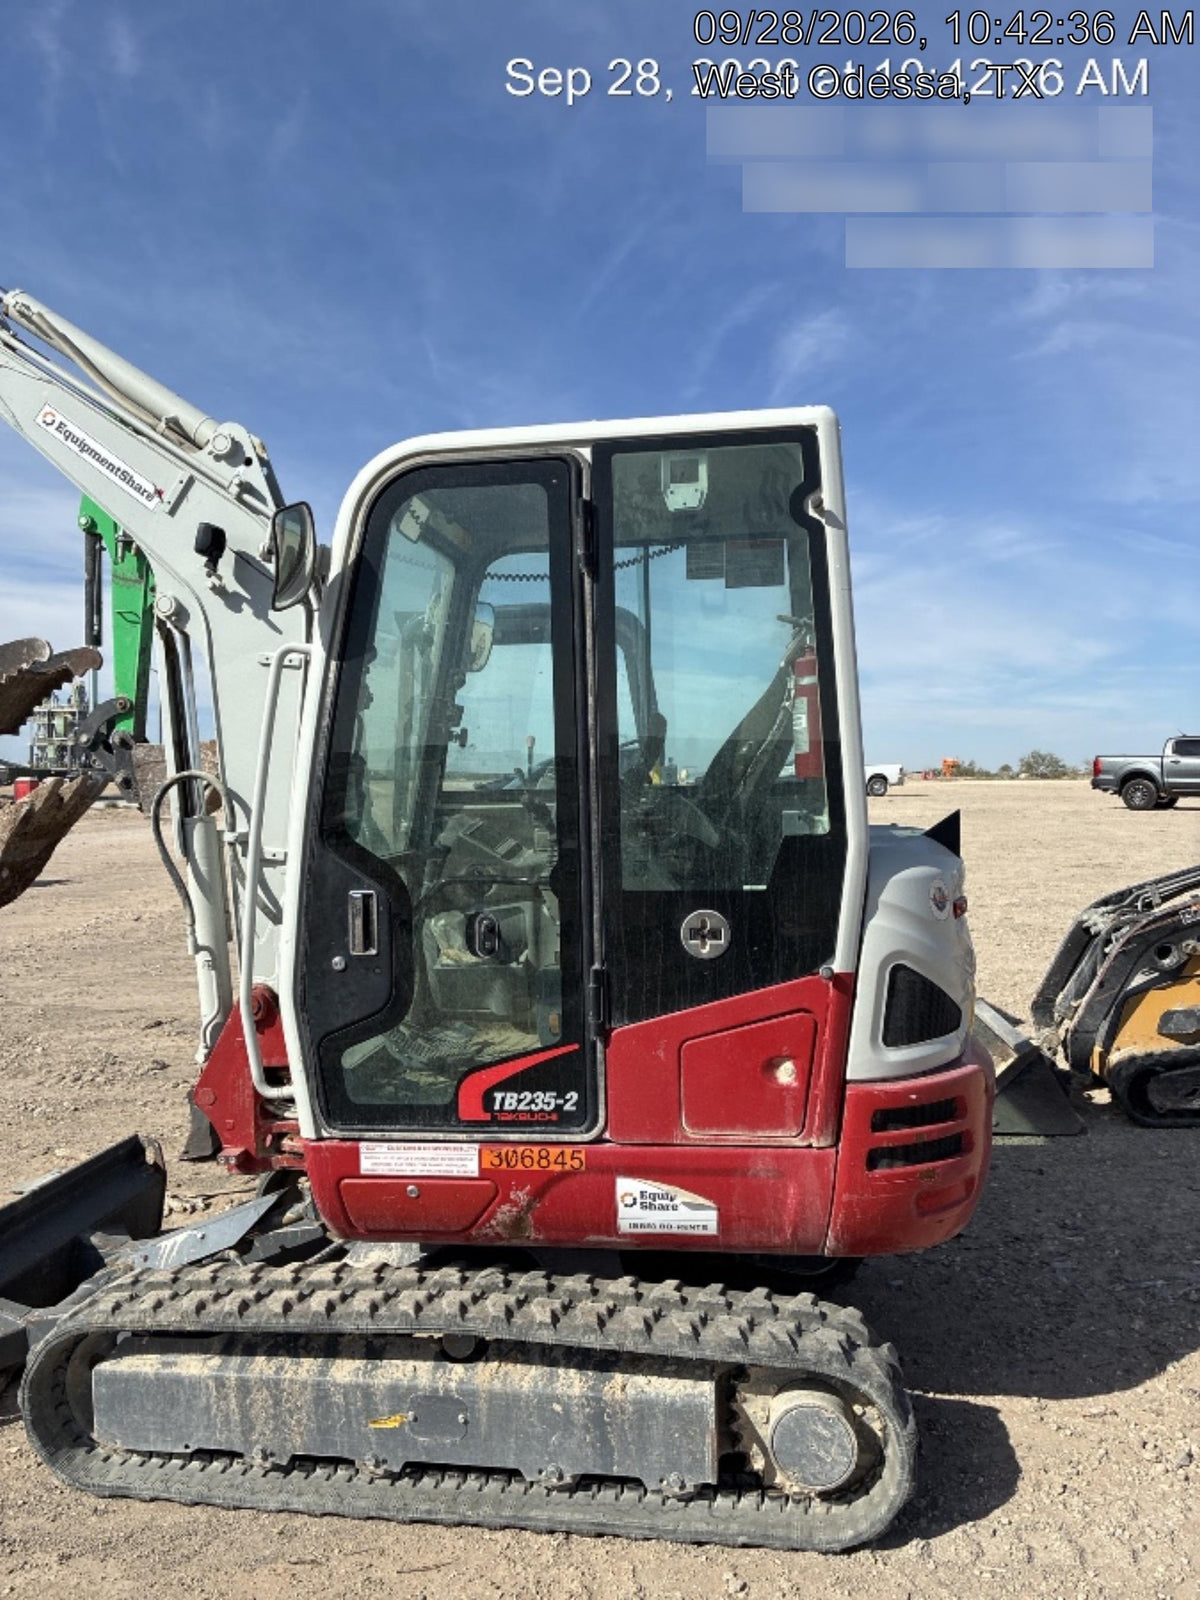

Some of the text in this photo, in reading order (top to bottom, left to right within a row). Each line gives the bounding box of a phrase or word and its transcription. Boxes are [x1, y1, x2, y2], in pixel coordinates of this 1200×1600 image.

[55, 421, 156, 502] EquipmentShare
[493, 1091, 579, 1111] TB235-2
[489, 1148, 584, 1171] 306845
[640, 1201, 679, 1212] Share
